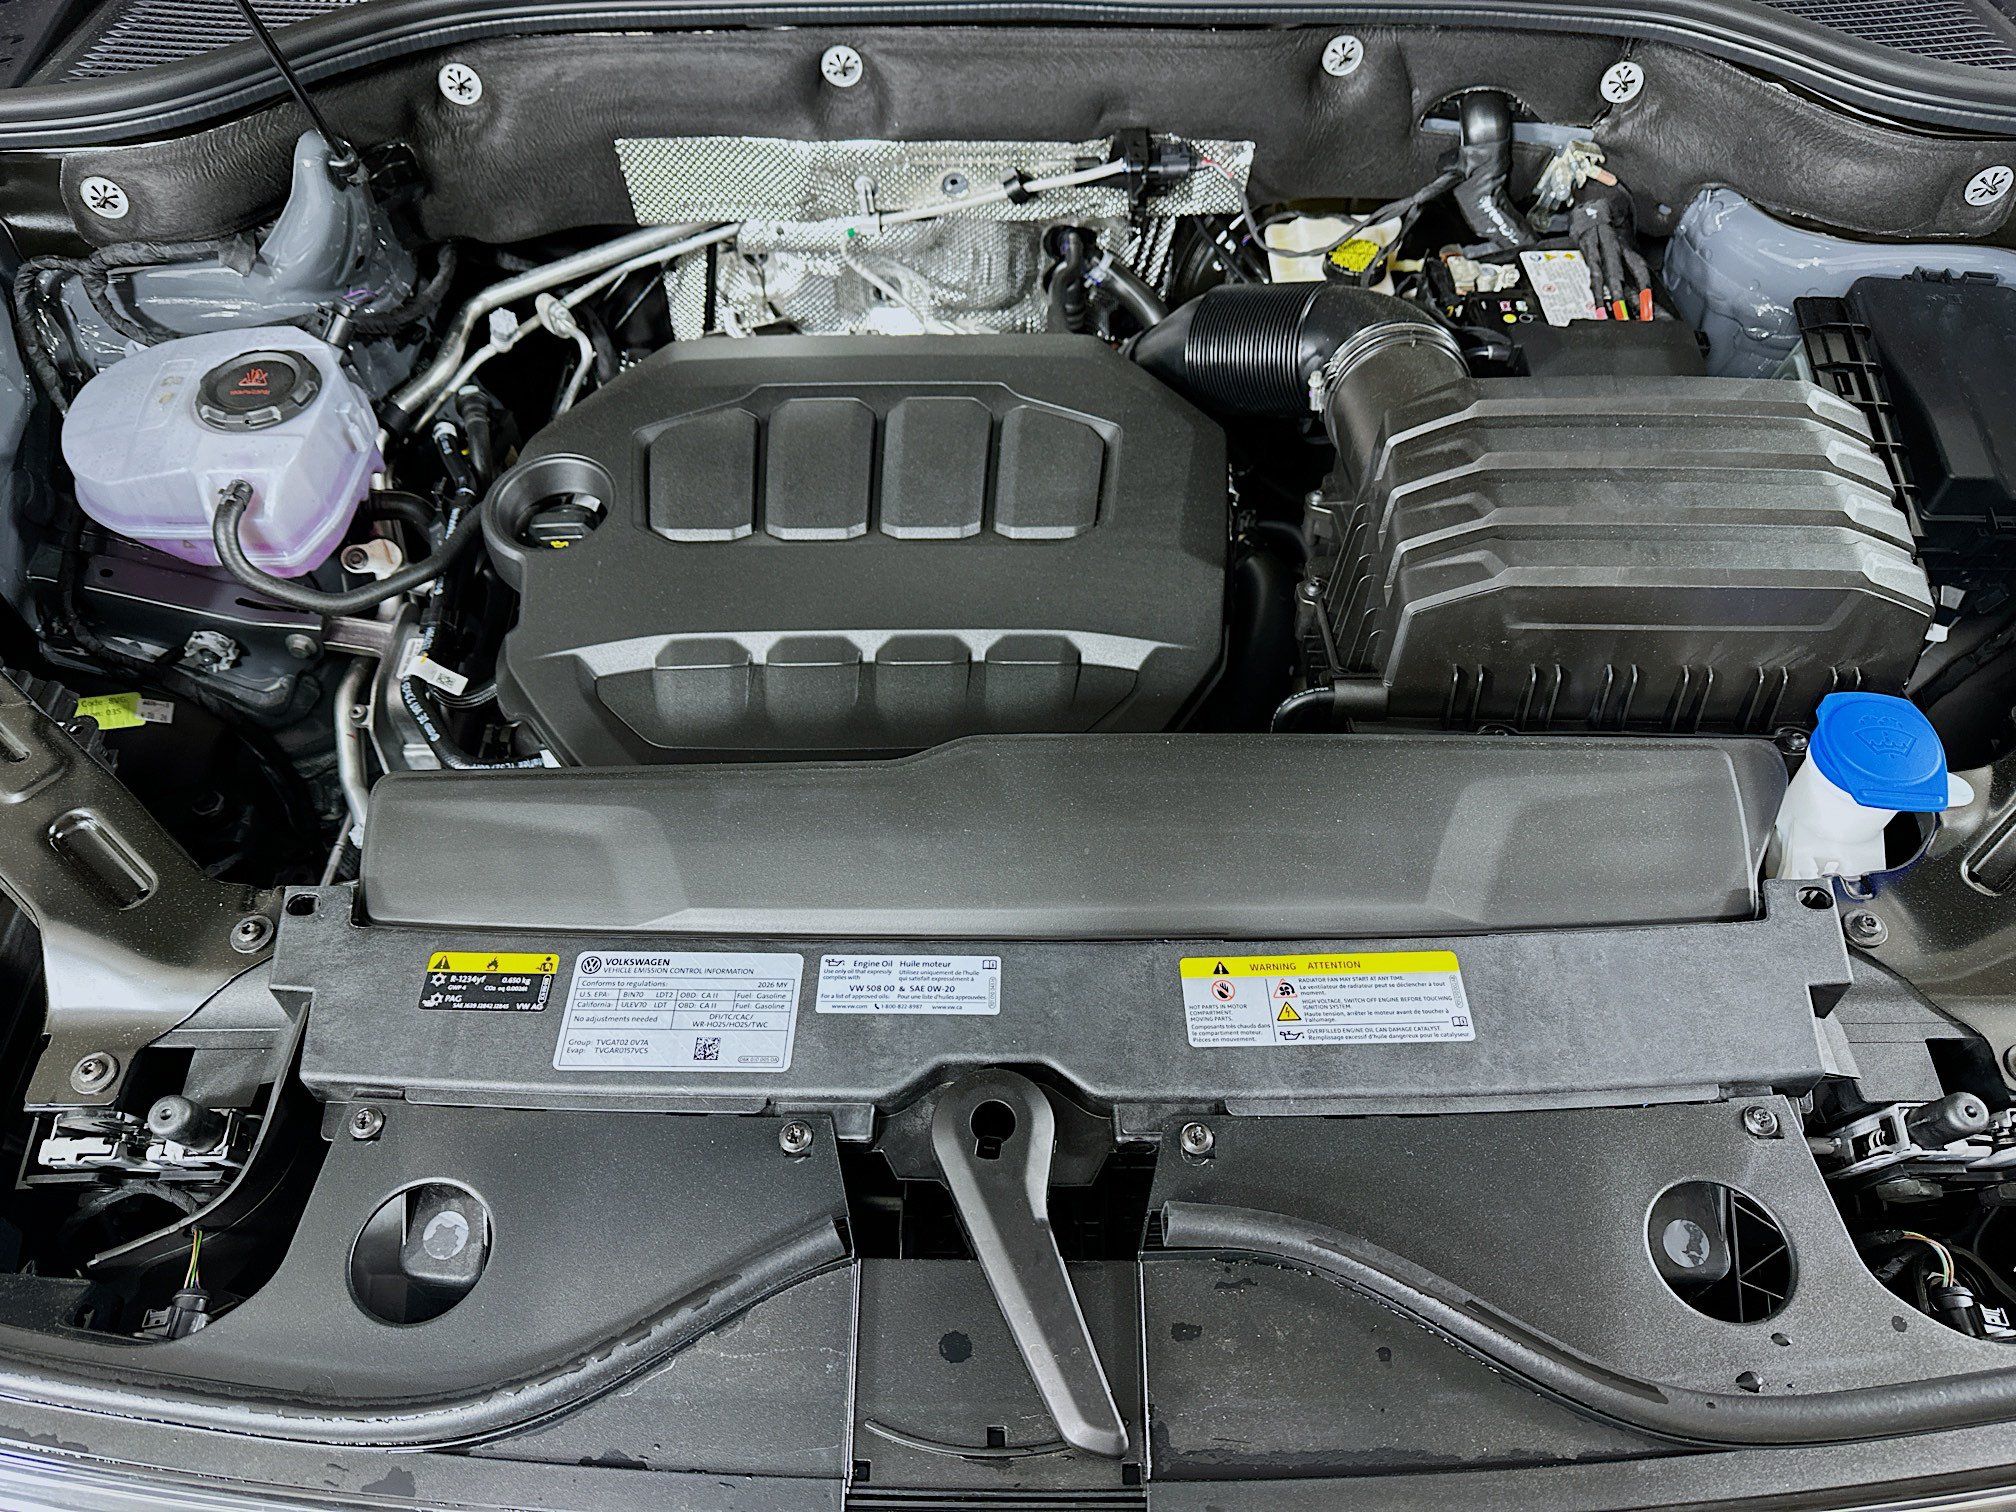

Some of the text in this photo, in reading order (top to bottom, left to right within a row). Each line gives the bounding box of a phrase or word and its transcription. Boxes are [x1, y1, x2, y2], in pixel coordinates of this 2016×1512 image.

[605, 958, 671, 966] VOLKSWAGEN
[853, 960, 880, 969] Engine
[899, 960, 921, 968] Huile
[1308, 961, 1361, 970] ATTENTION
[1249, 963, 1296, 971] WARNING
[522, 977, 531, 985] kg
[626, 980, 668, 989] regulations:
[586, 1015, 630, 1023] adjustments
[566, 1047, 586, 1055] Evap:
